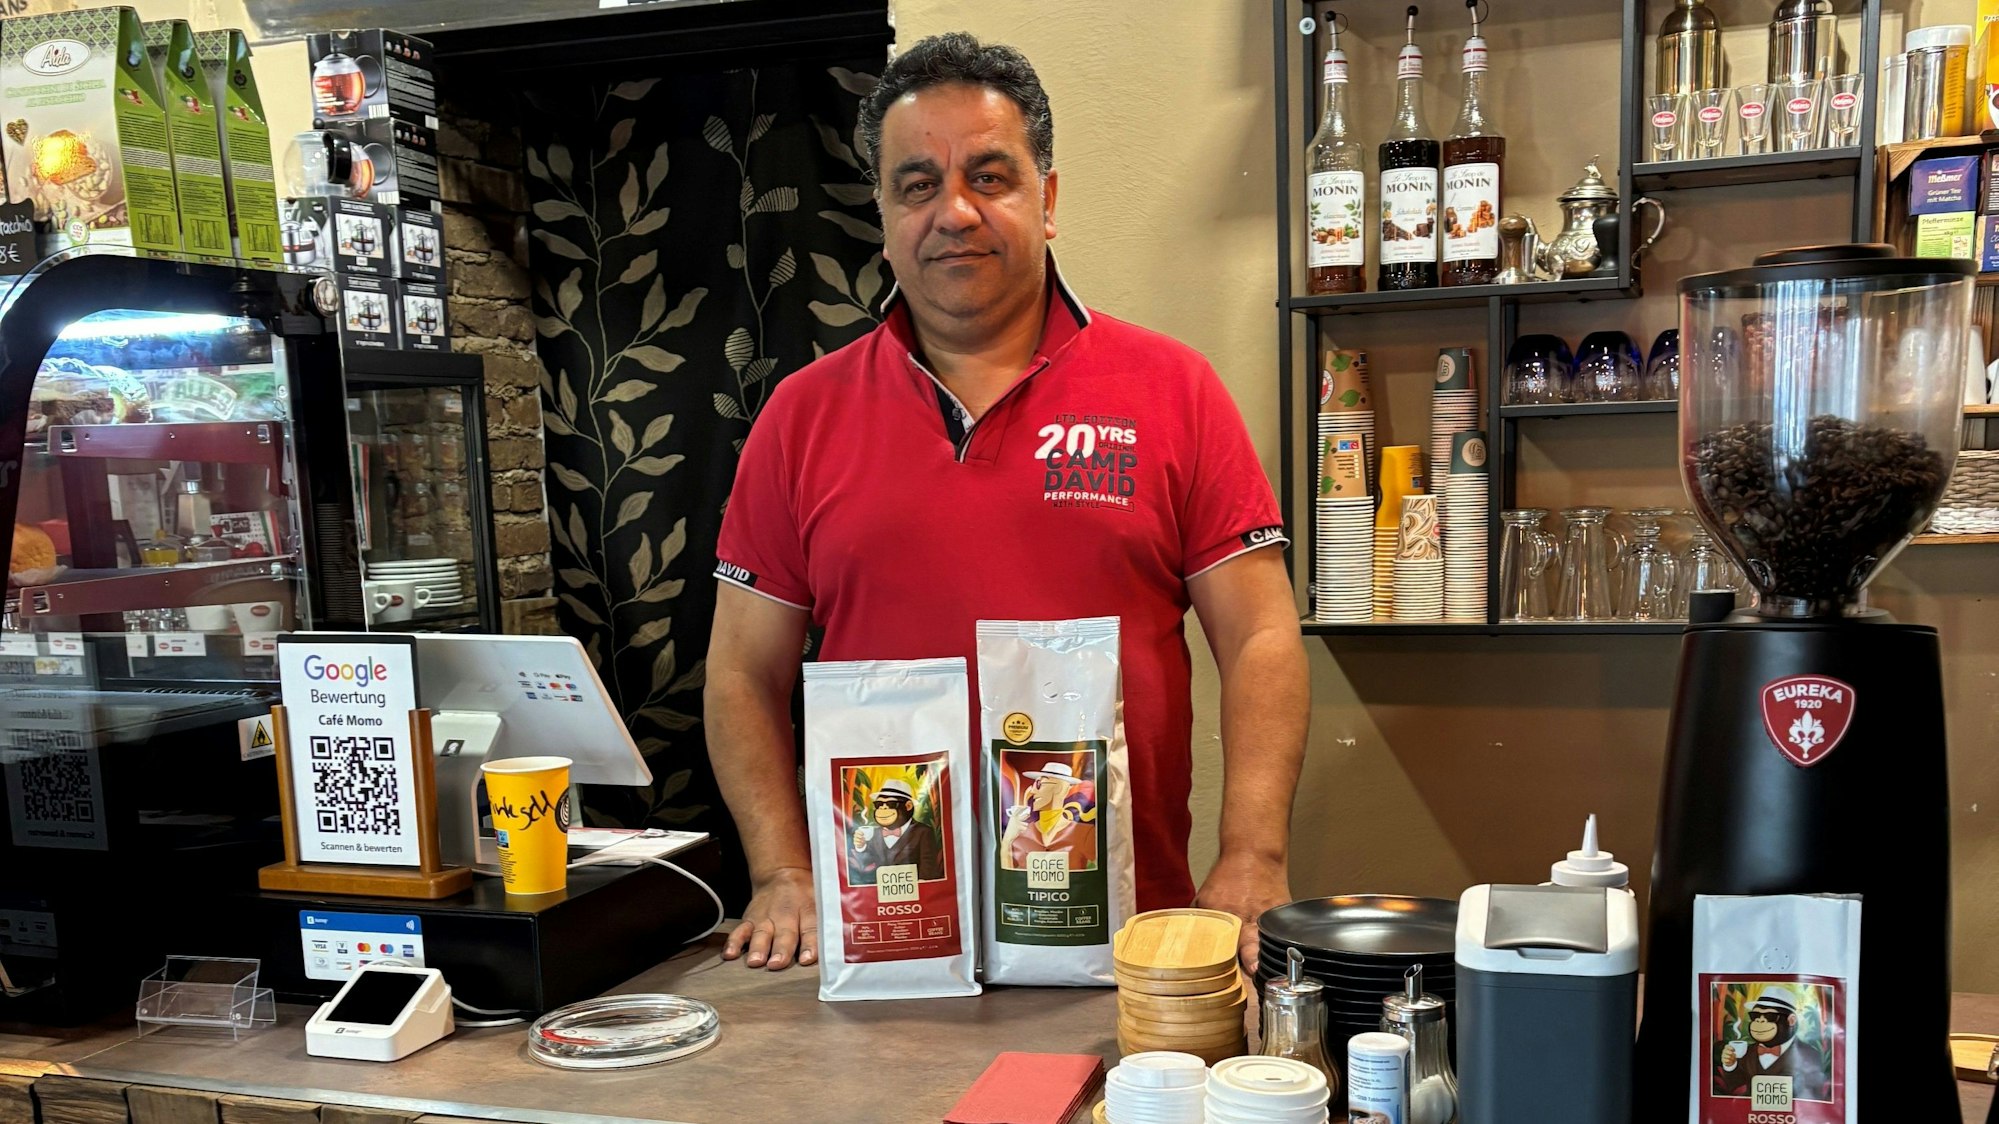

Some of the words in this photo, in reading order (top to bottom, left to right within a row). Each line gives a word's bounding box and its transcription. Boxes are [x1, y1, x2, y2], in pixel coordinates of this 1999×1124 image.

[41, 44, 71, 69] Aida
[1313, 185, 1358, 197] MONIN
[1386, 182, 1432, 194] MONIN
[1445, 178, 1491, 191] MONIN
[1034, 423, 1096, 460] 20
[1097, 425, 1137, 445] YRS
[1046, 448, 1137, 474] CAMP
[1045, 470, 1135, 497] DAVID
[1043, 491, 1129, 506] PERFORMANCE
[304, 654, 388, 688] Google
[310, 689, 387, 708] Bewertung
[1773, 684, 1843, 704] EUREKA
[1794, 699, 1823, 709] 1920
[318, 714, 344, 726] Café
[346, 715, 383, 727] Momo
[320, 841, 355, 852] Scannen
[355, 843, 363, 852] &
[363, 843, 403, 854] bewerten
[1032, 859, 1064, 870] CAFE
[881, 871, 914, 884] CAFE
[1032, 870, 1065, 882] MOMO
[882, 883, 914, 896] MOMO
[1027, 891, 1070, 902] TIPICO
[877, 904, 923, 916] ROSSO
[1756, 1082, 1788, 1093] CAFE
[1756, 1094, 1788, 1105] MOMO
[1747, 1113, 1796, 1124] ROSSO
